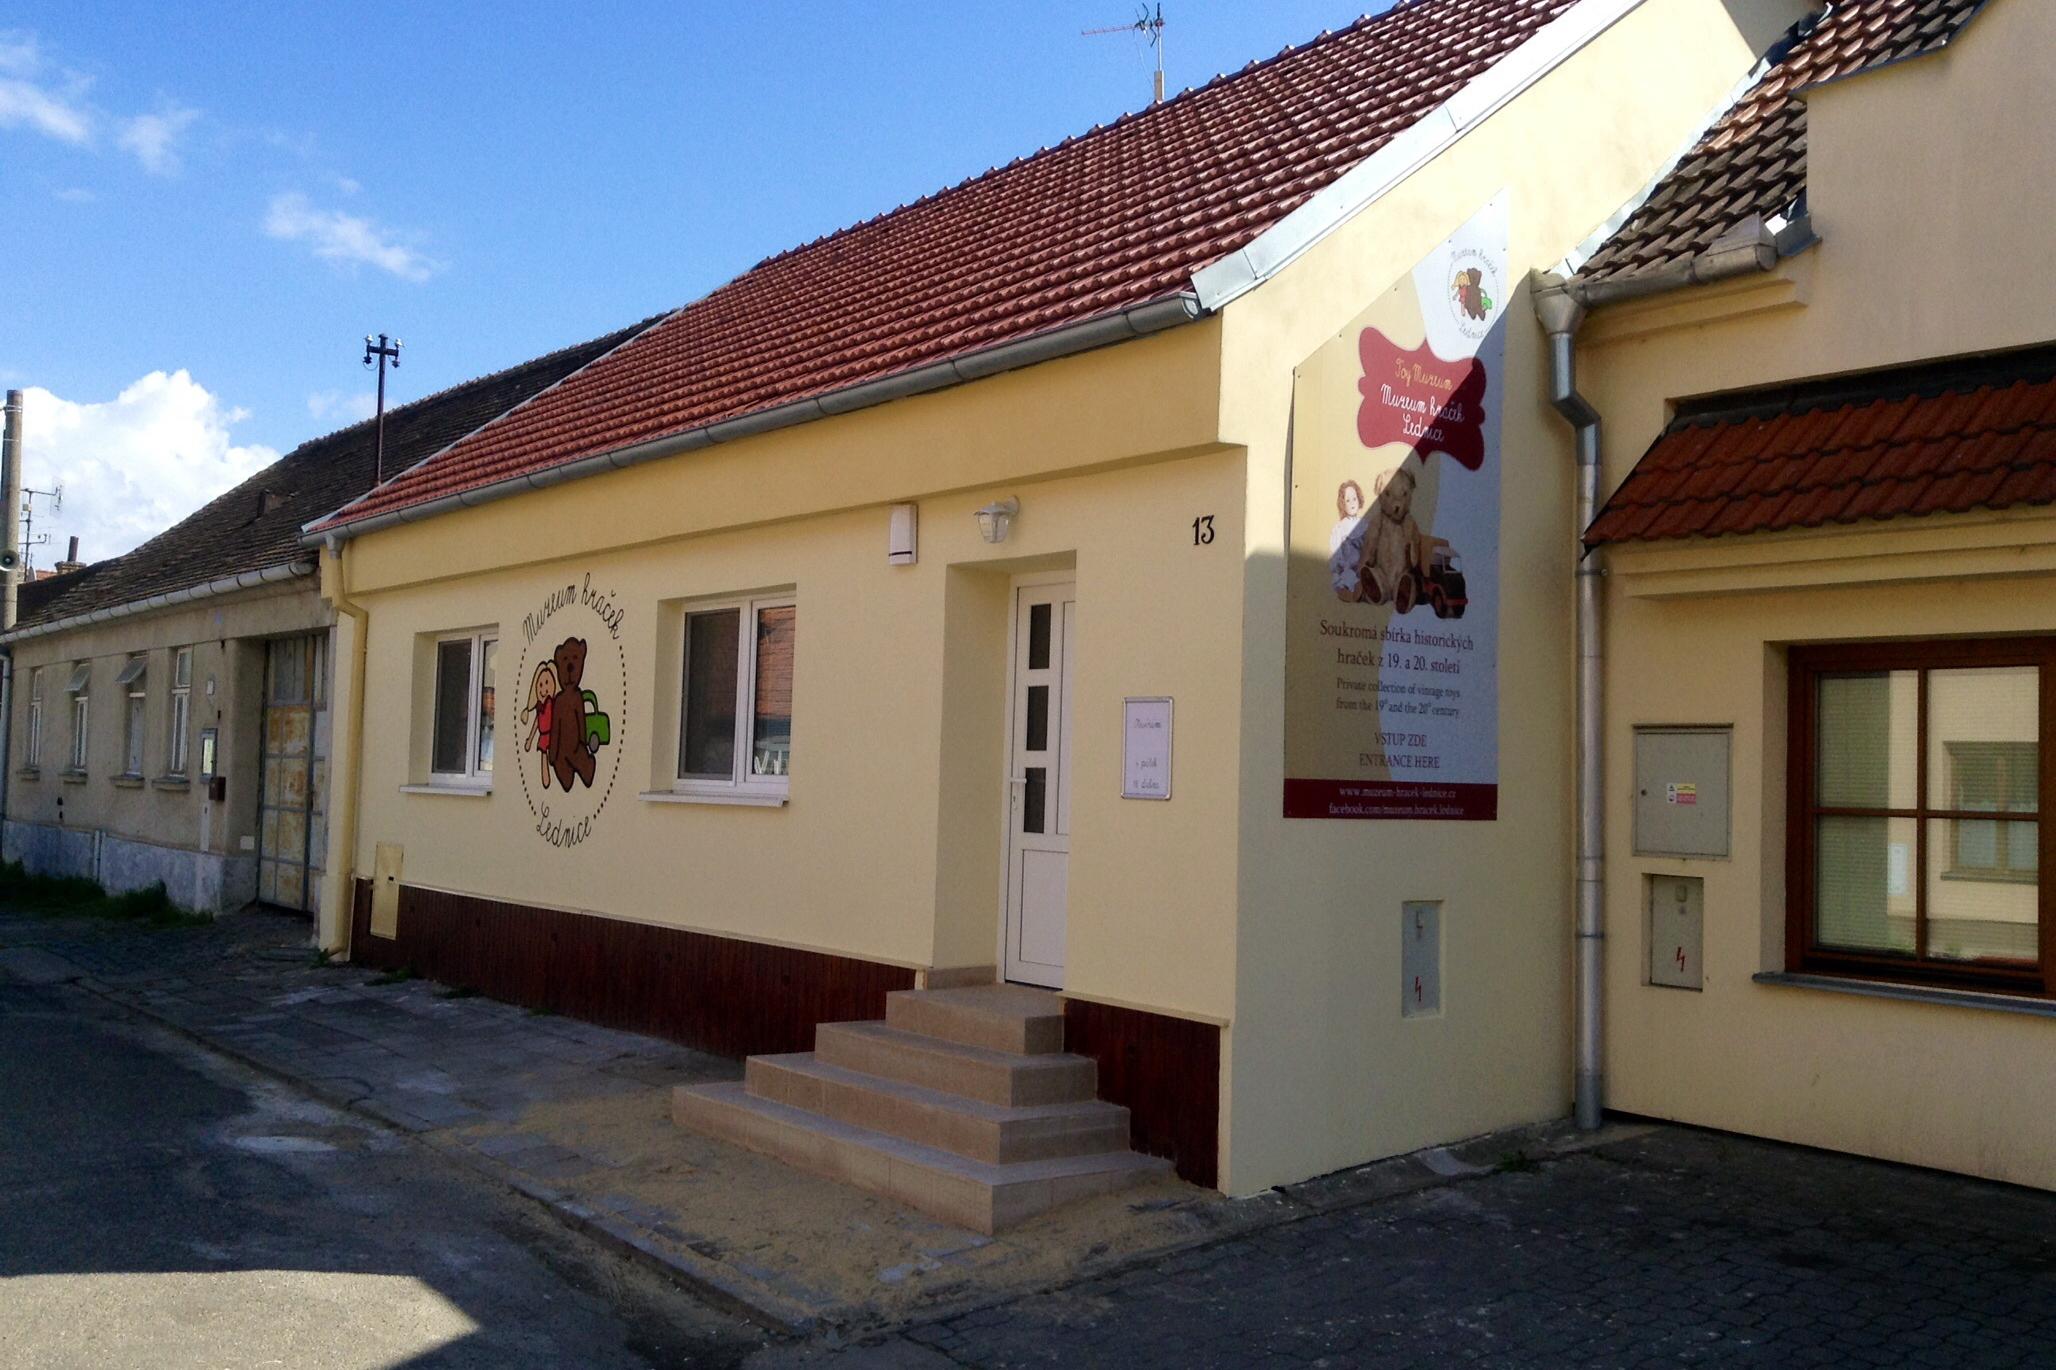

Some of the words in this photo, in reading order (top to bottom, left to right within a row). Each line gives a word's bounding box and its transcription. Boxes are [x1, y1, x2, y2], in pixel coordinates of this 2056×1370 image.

[1192, 514, 1215, 546] 13
[522, 584, 578, 646] Muzeum
[580, 572, 625, 640] hraček
[1414, 629, 1474, 653] historických
[1336, 648, 1376, 667] hraček
[1387, 652, 1402, 669] 19.
[1404, 659, 1411, 670] a
[1413, 655, 1428, 672] 20.
[1430, 657, 1460, 675] století
[1407, 734, 1428, 748] ZDE
[1359, 753, 1412, 769] ENTRANCE
[1414, 755, 1440, 770] HERE
[536, 801, 592, 849] Lednice
